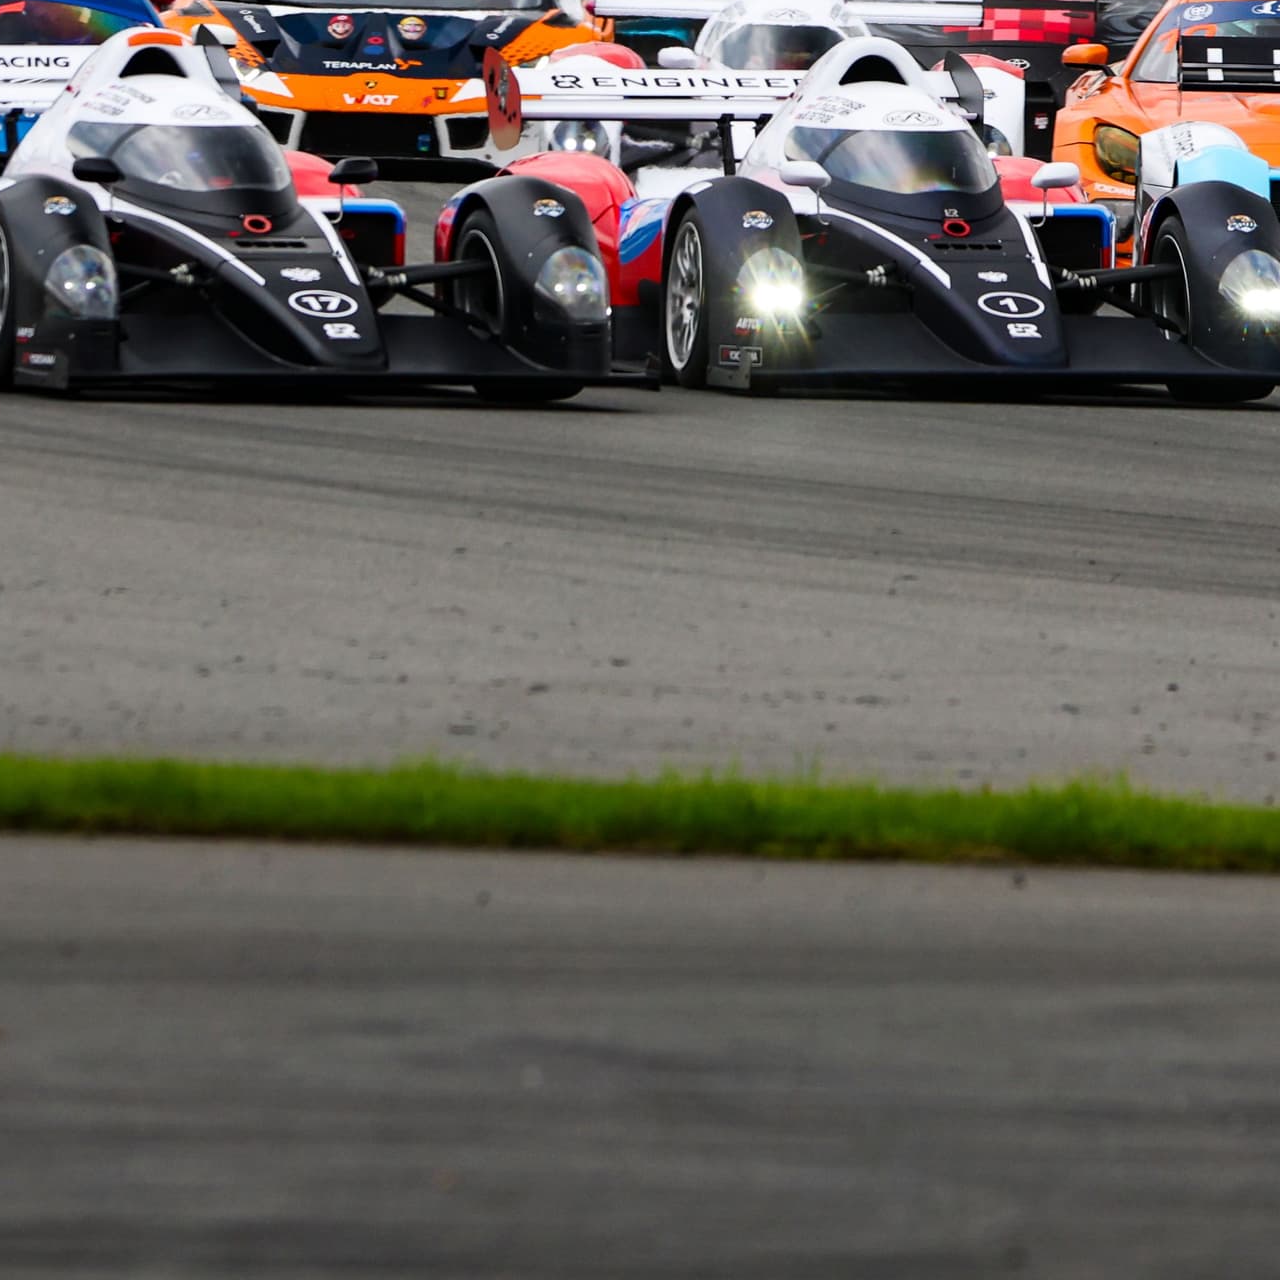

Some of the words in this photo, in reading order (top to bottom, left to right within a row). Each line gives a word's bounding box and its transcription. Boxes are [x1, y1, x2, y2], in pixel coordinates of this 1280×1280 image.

[322, 60, 397, 71] TERAPLAN
[301, 295, 343, 312] 17
[999, 296, 1019, 313] 1
